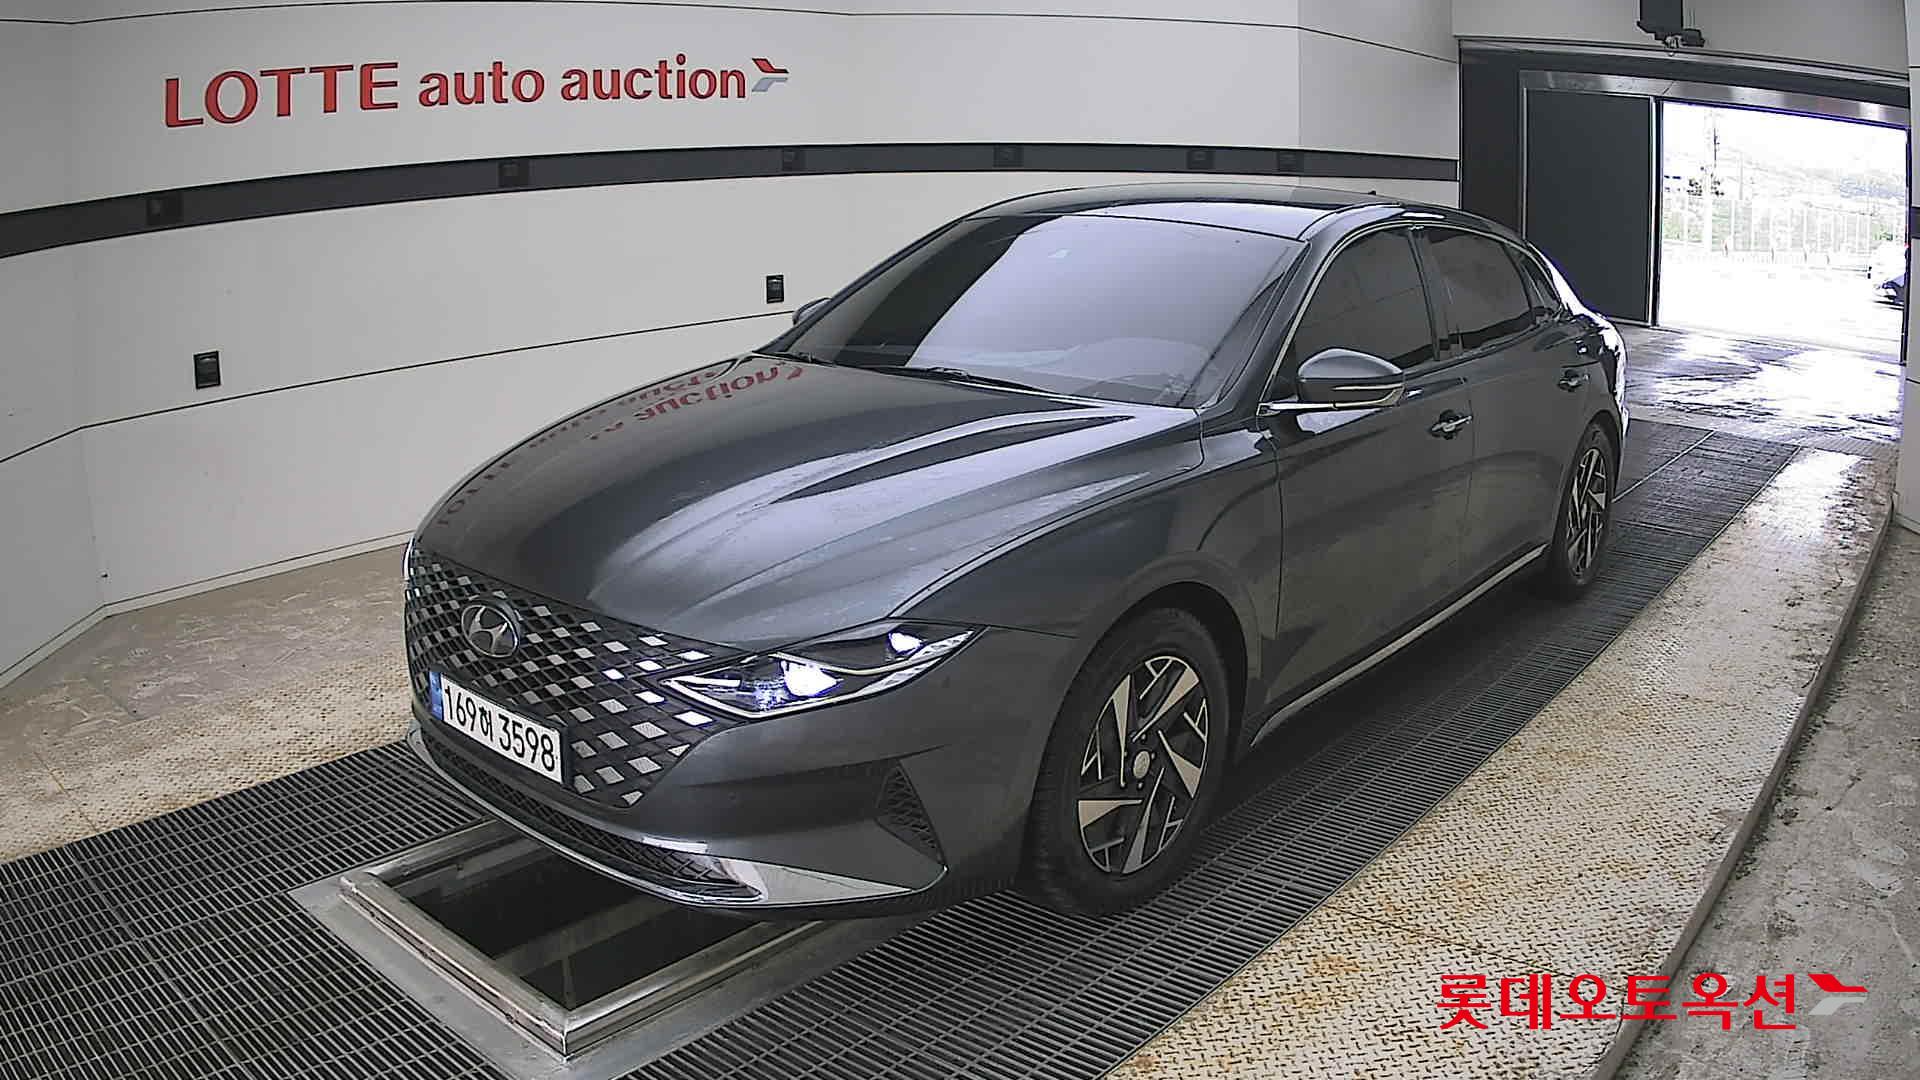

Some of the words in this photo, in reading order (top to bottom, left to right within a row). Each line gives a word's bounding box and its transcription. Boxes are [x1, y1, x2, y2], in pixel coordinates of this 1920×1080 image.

[164, 62, 400, 128] LOTTE
[418, 60, 546, 108] auto
[560, 53, 747, 102] auction
